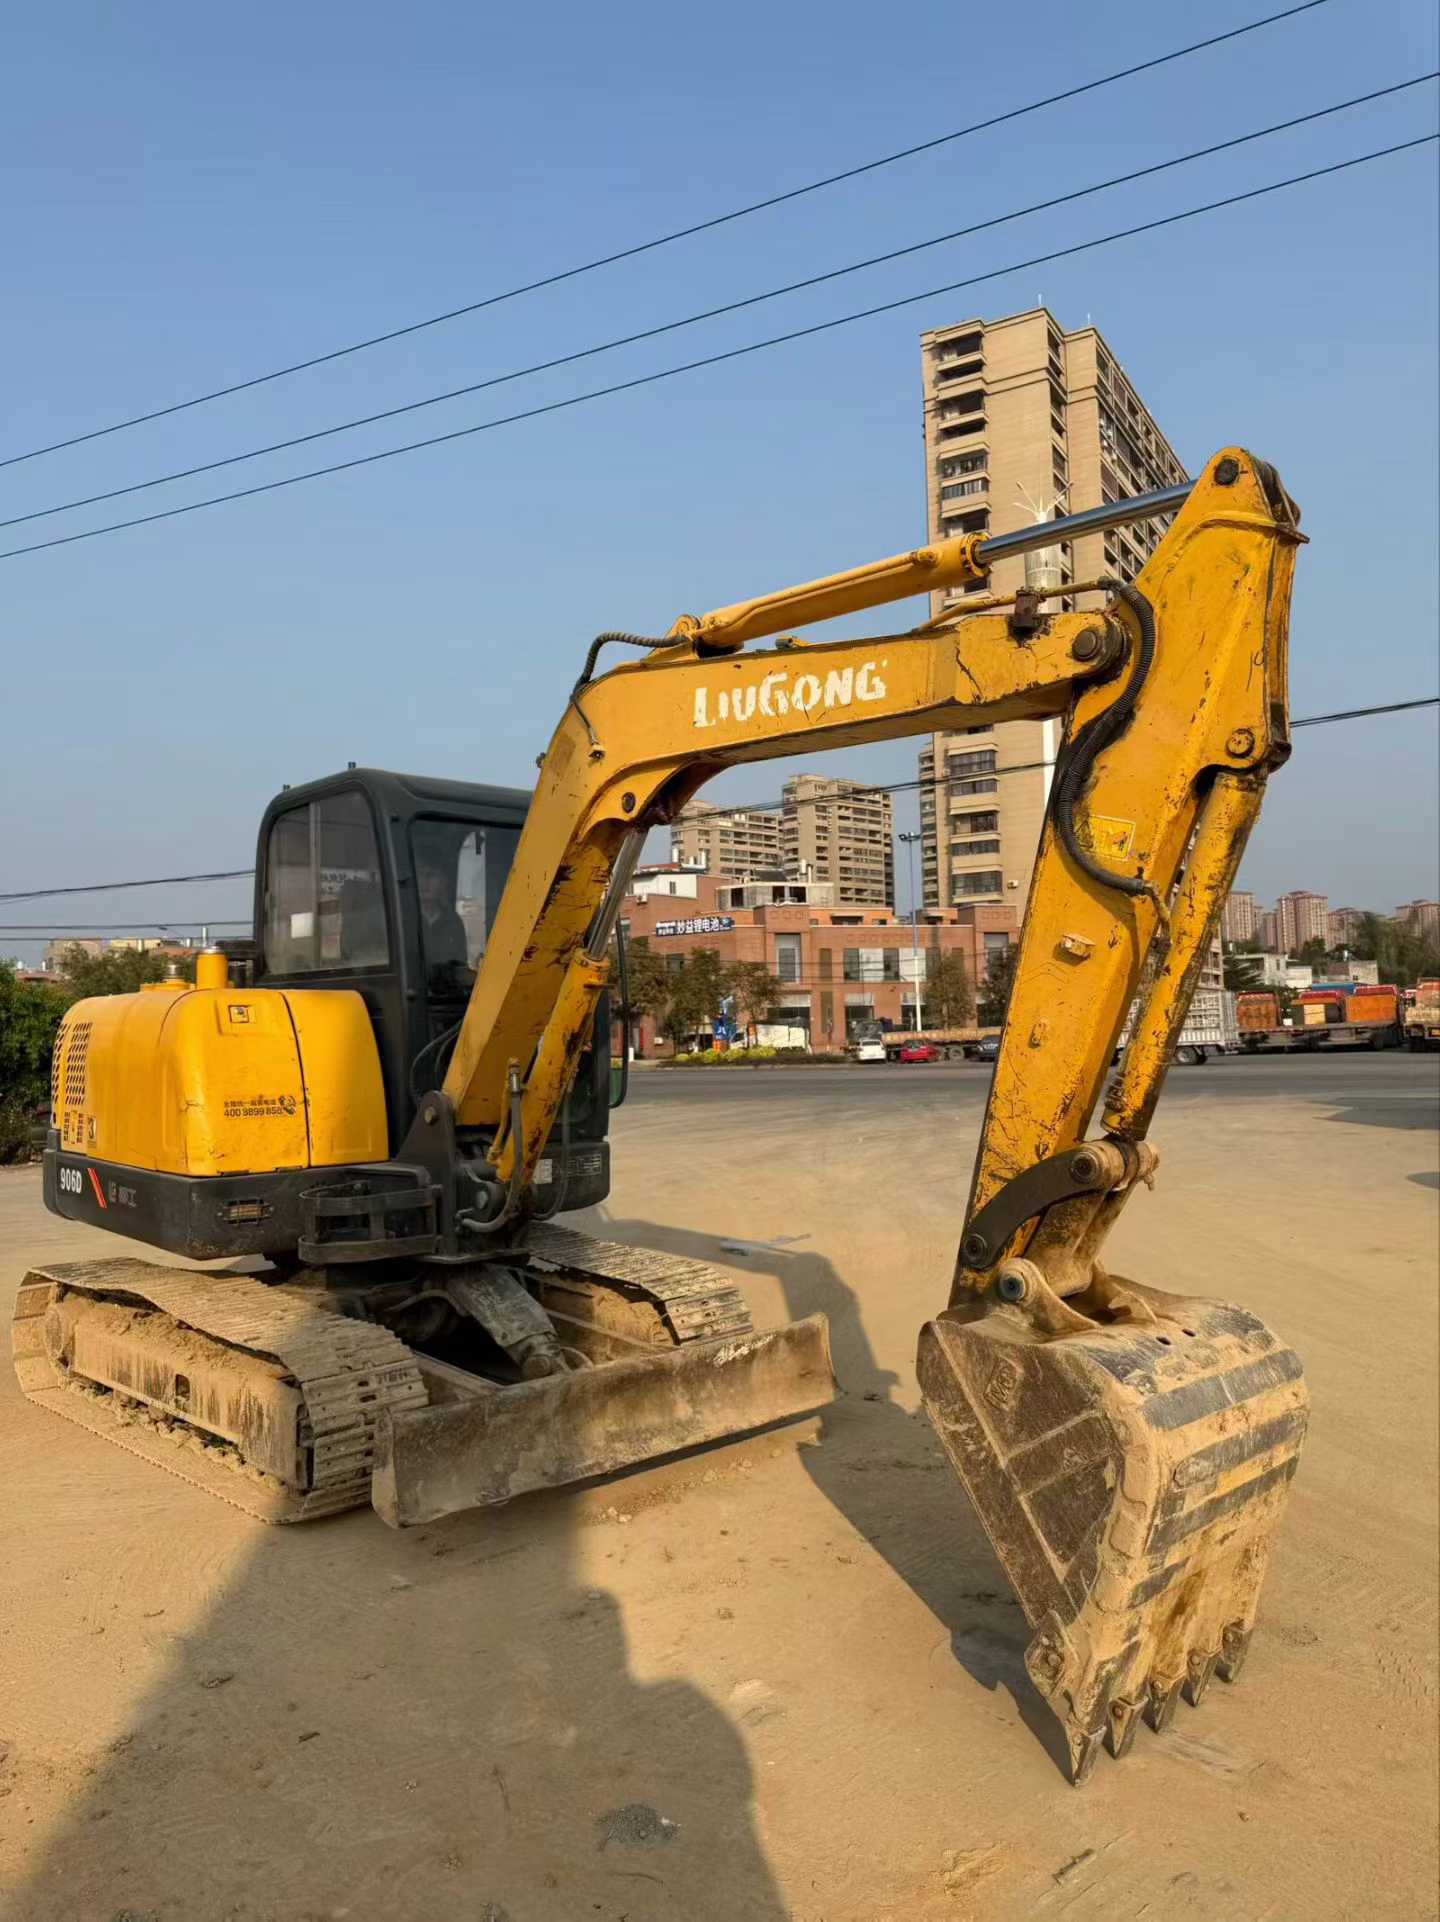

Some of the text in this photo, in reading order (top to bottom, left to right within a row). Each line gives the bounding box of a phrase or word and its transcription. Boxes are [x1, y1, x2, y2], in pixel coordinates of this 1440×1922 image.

[693, 662, 887, 728] LIUGONG
[224, 1108, 241, 1118] 400
[60, 1167, 82, 1194] 906D
